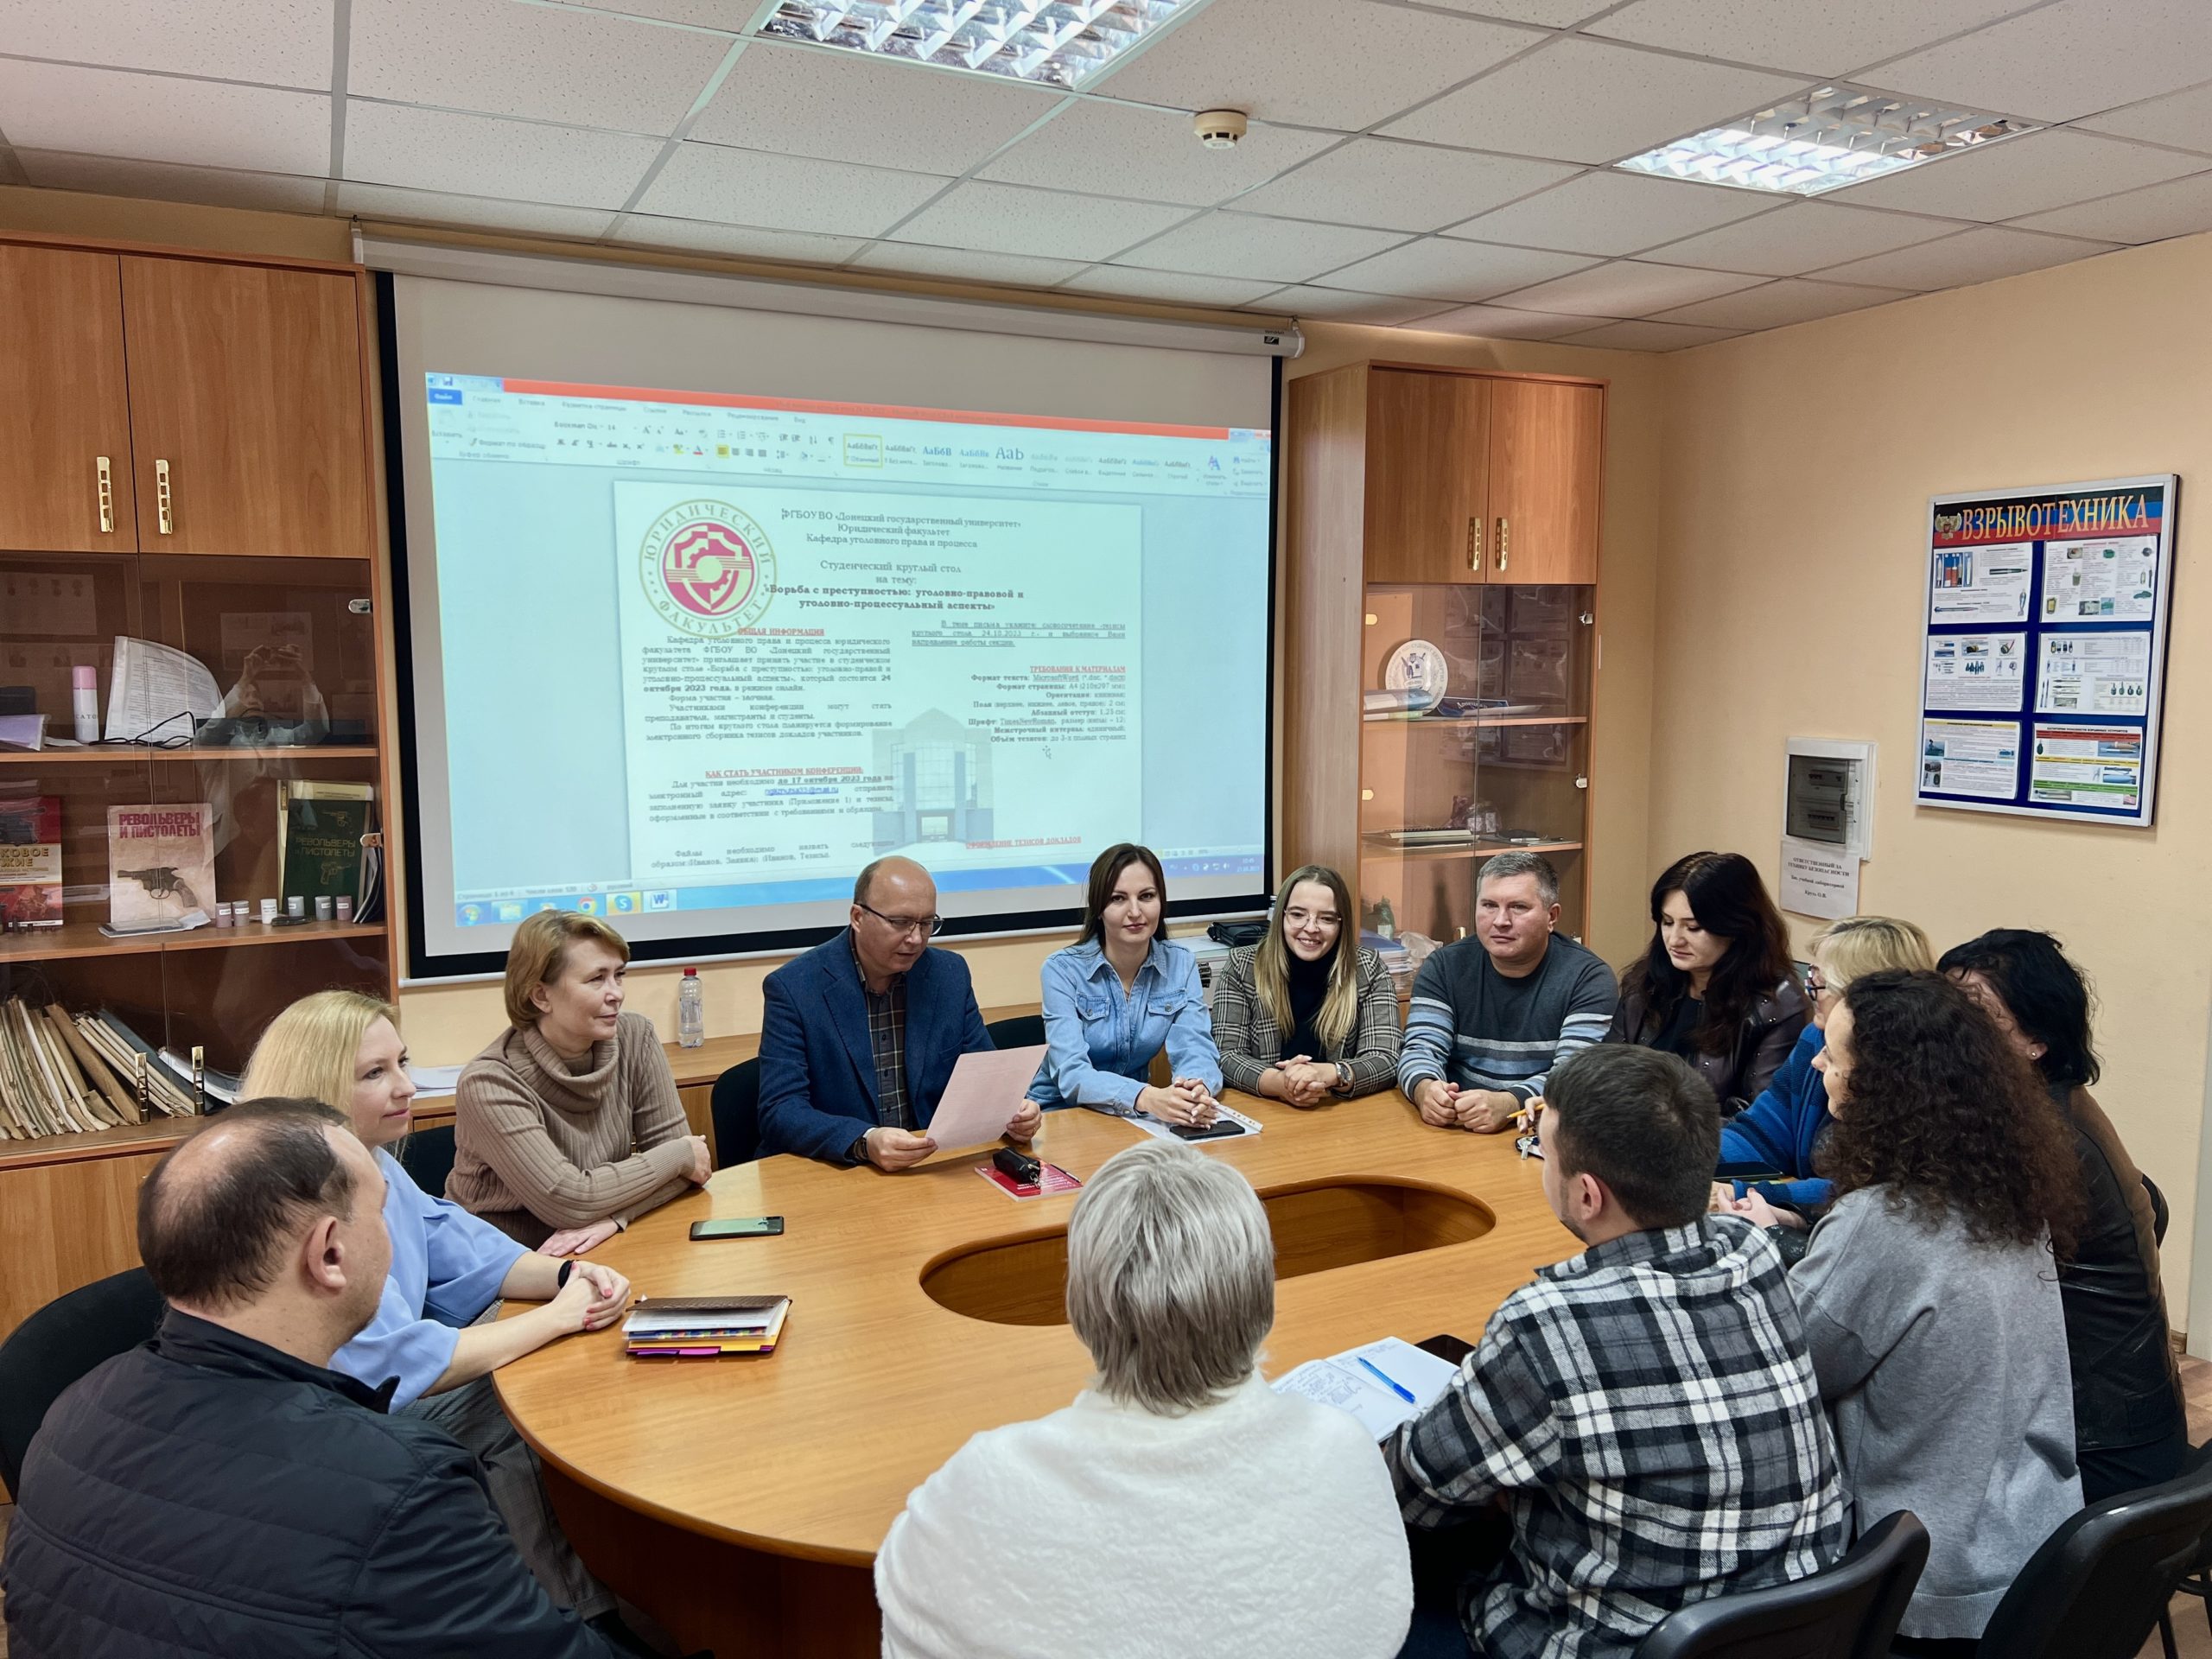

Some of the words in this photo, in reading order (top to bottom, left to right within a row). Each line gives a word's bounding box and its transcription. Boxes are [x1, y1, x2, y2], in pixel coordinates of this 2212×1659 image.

[1962, 493, 2149, 541] ВЗРЫВОТЕХНИКА
[837, 523, 903, 534] Юридический
[904, 526, 950, 537] факультет
[806, 533, 848, 544] Кафедра
[849, 537, 899, 545] уголовного
[901, 538, 928, 548] права
[937, 540, 978, 549] процесса
[820, 560, 892, 571] Студенческий
[896, 563, 938, 574] круглый
[940, 565, 962, 574] стол
[915, 589, 1014, 600] уголовно-правовой
[799, 600, 944, 610] уголовно-процессуальный
[118, 812, 200, 825] РЕВОЛЬВЕРЫ
[119, 826, 128, 838] И
[131, 824, 200, 838] ПИСТОЛЕТЫ
[296, 836, 356, 848] РЕВОЛЬВЕРЫ
